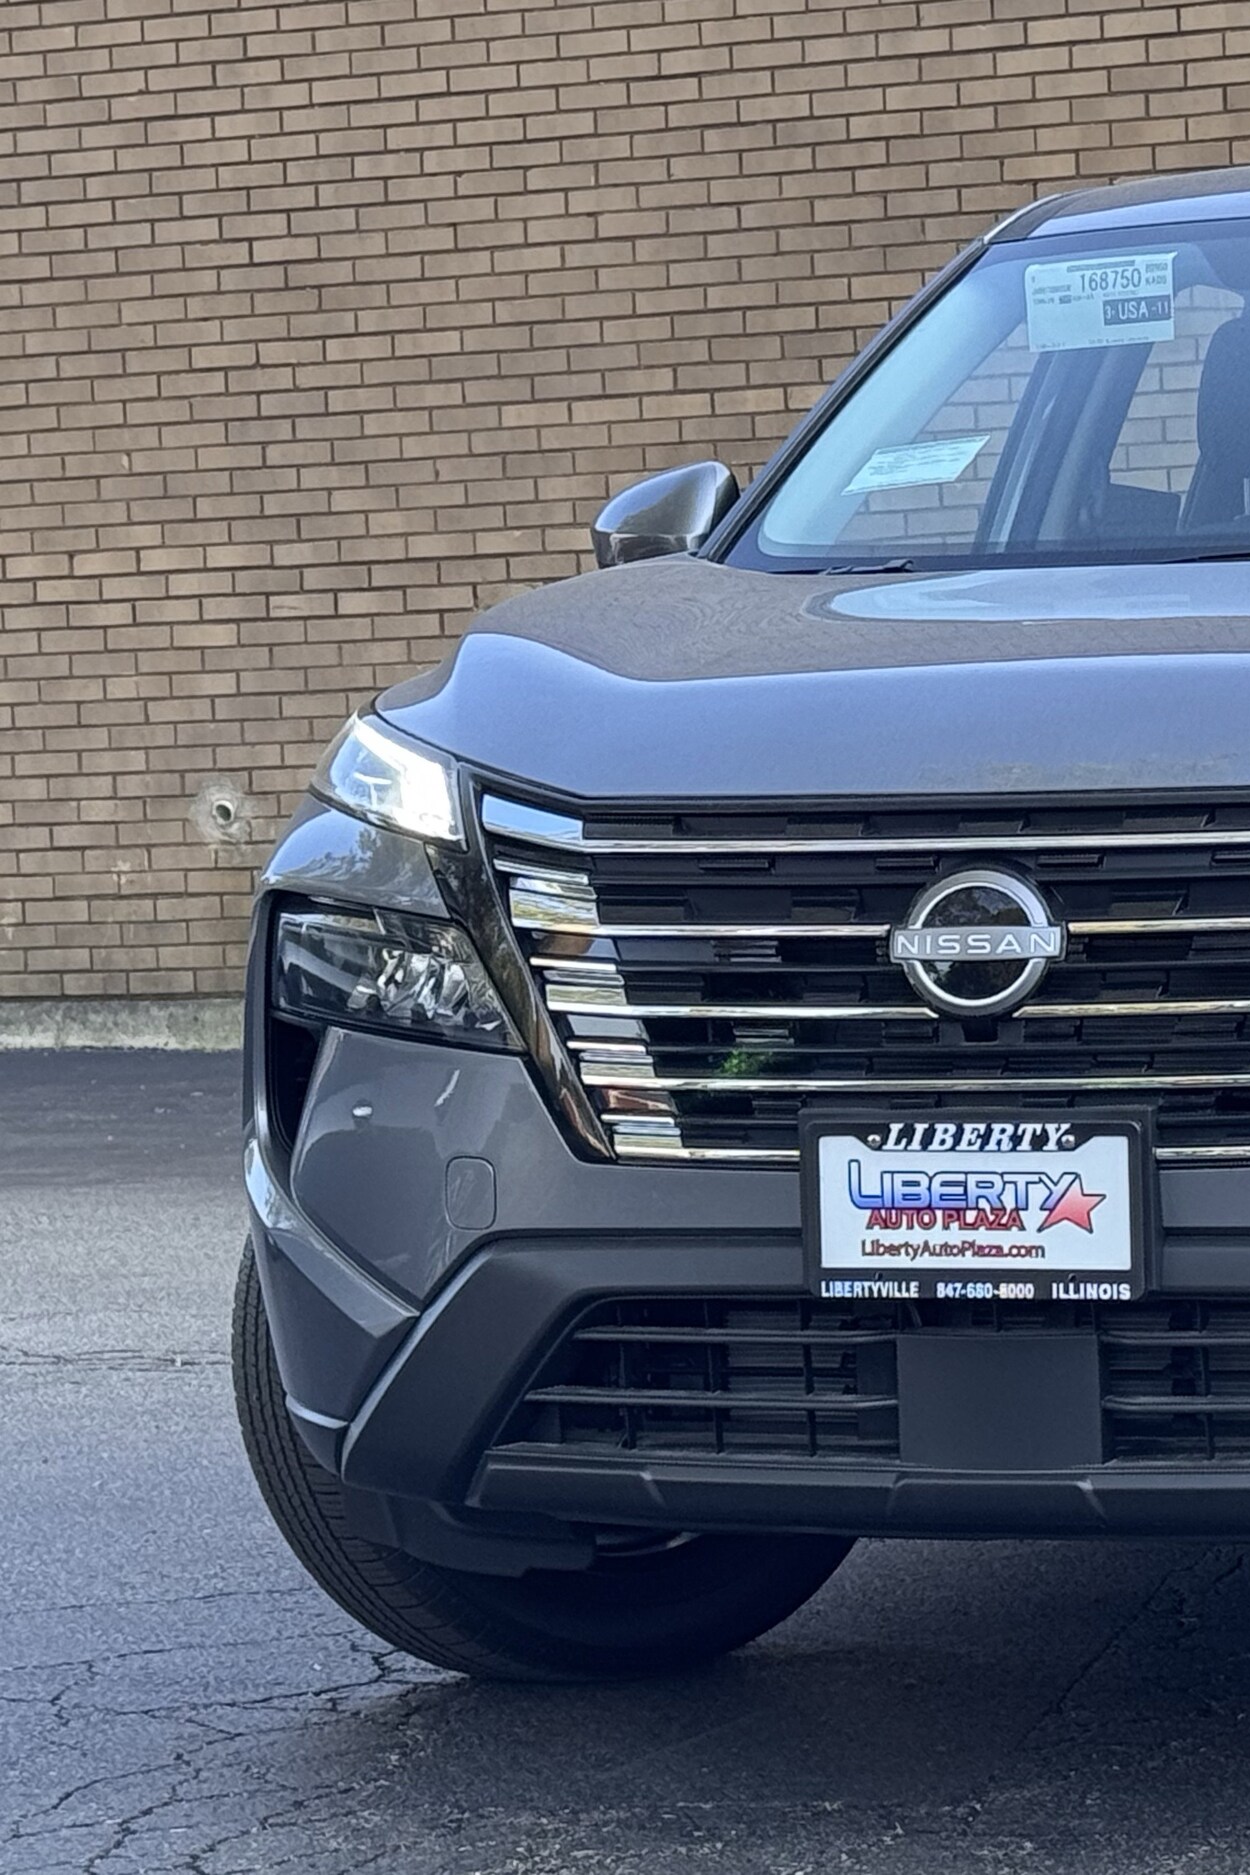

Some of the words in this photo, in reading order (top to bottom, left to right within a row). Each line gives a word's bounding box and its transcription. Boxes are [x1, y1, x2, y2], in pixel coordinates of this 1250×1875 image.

[1079, 268, 1142, 293] 168750
[1118, 301, 1149, 319] USA
[897, 931, 1055, 955] NISSAN
[881, 1122, 1072, 1151] LIBERTY
[848, 1159, 1079, 1211] LIBERTY
[866, 1209, 936, 1230] AUTO
[942, 1209, 1025, 1231] PLAZA
[861, 1239, 1046, 1261] LibertyAutoPlaza.com
[821, 1281, 920, 1299] LIBERTYVILLE
[1051, 1282, 1131, 1300] ILLINOIS
